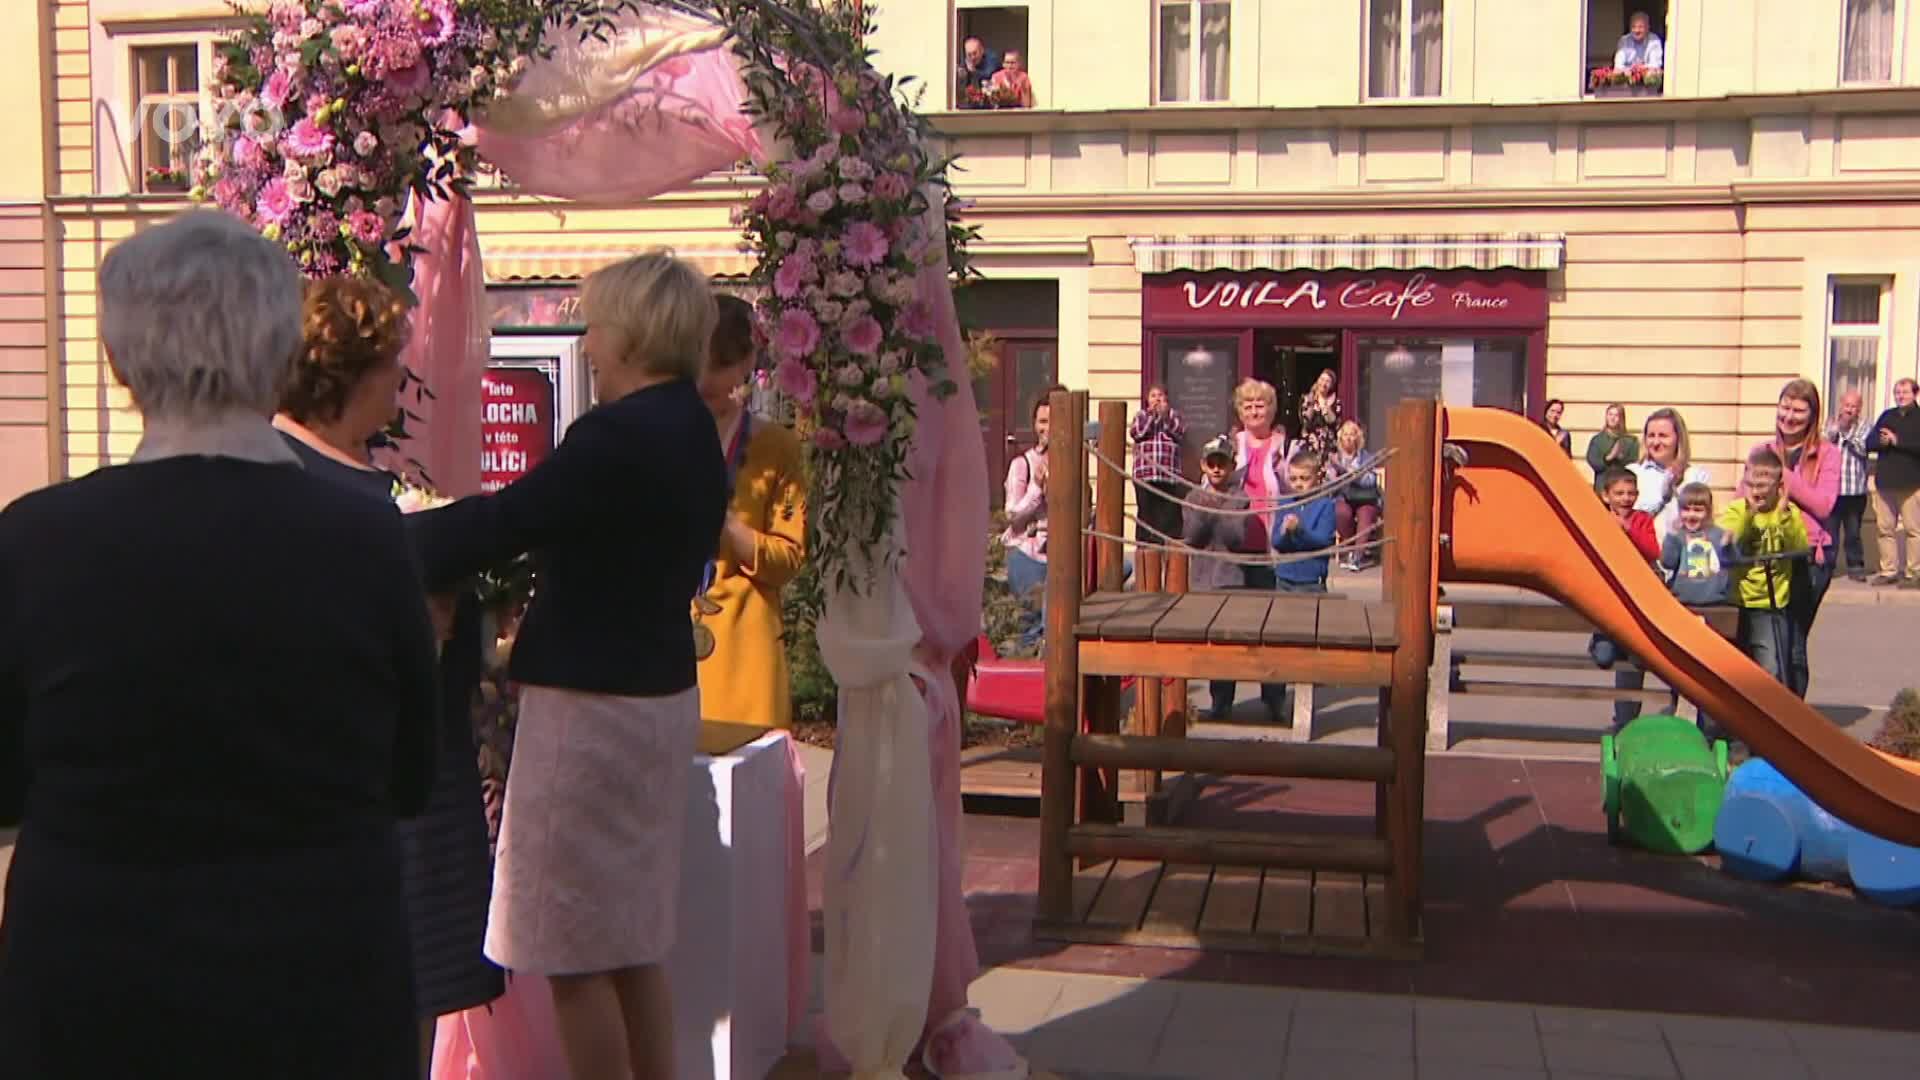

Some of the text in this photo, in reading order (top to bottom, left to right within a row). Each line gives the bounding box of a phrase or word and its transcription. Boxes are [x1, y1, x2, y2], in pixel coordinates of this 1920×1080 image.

[1183, 273, 1509, 321] VOILA Café France
[488, 382, 514, 396] Tato
[481, 402, 538, 424] LOCHA
[484, 432, 492, 443] v
